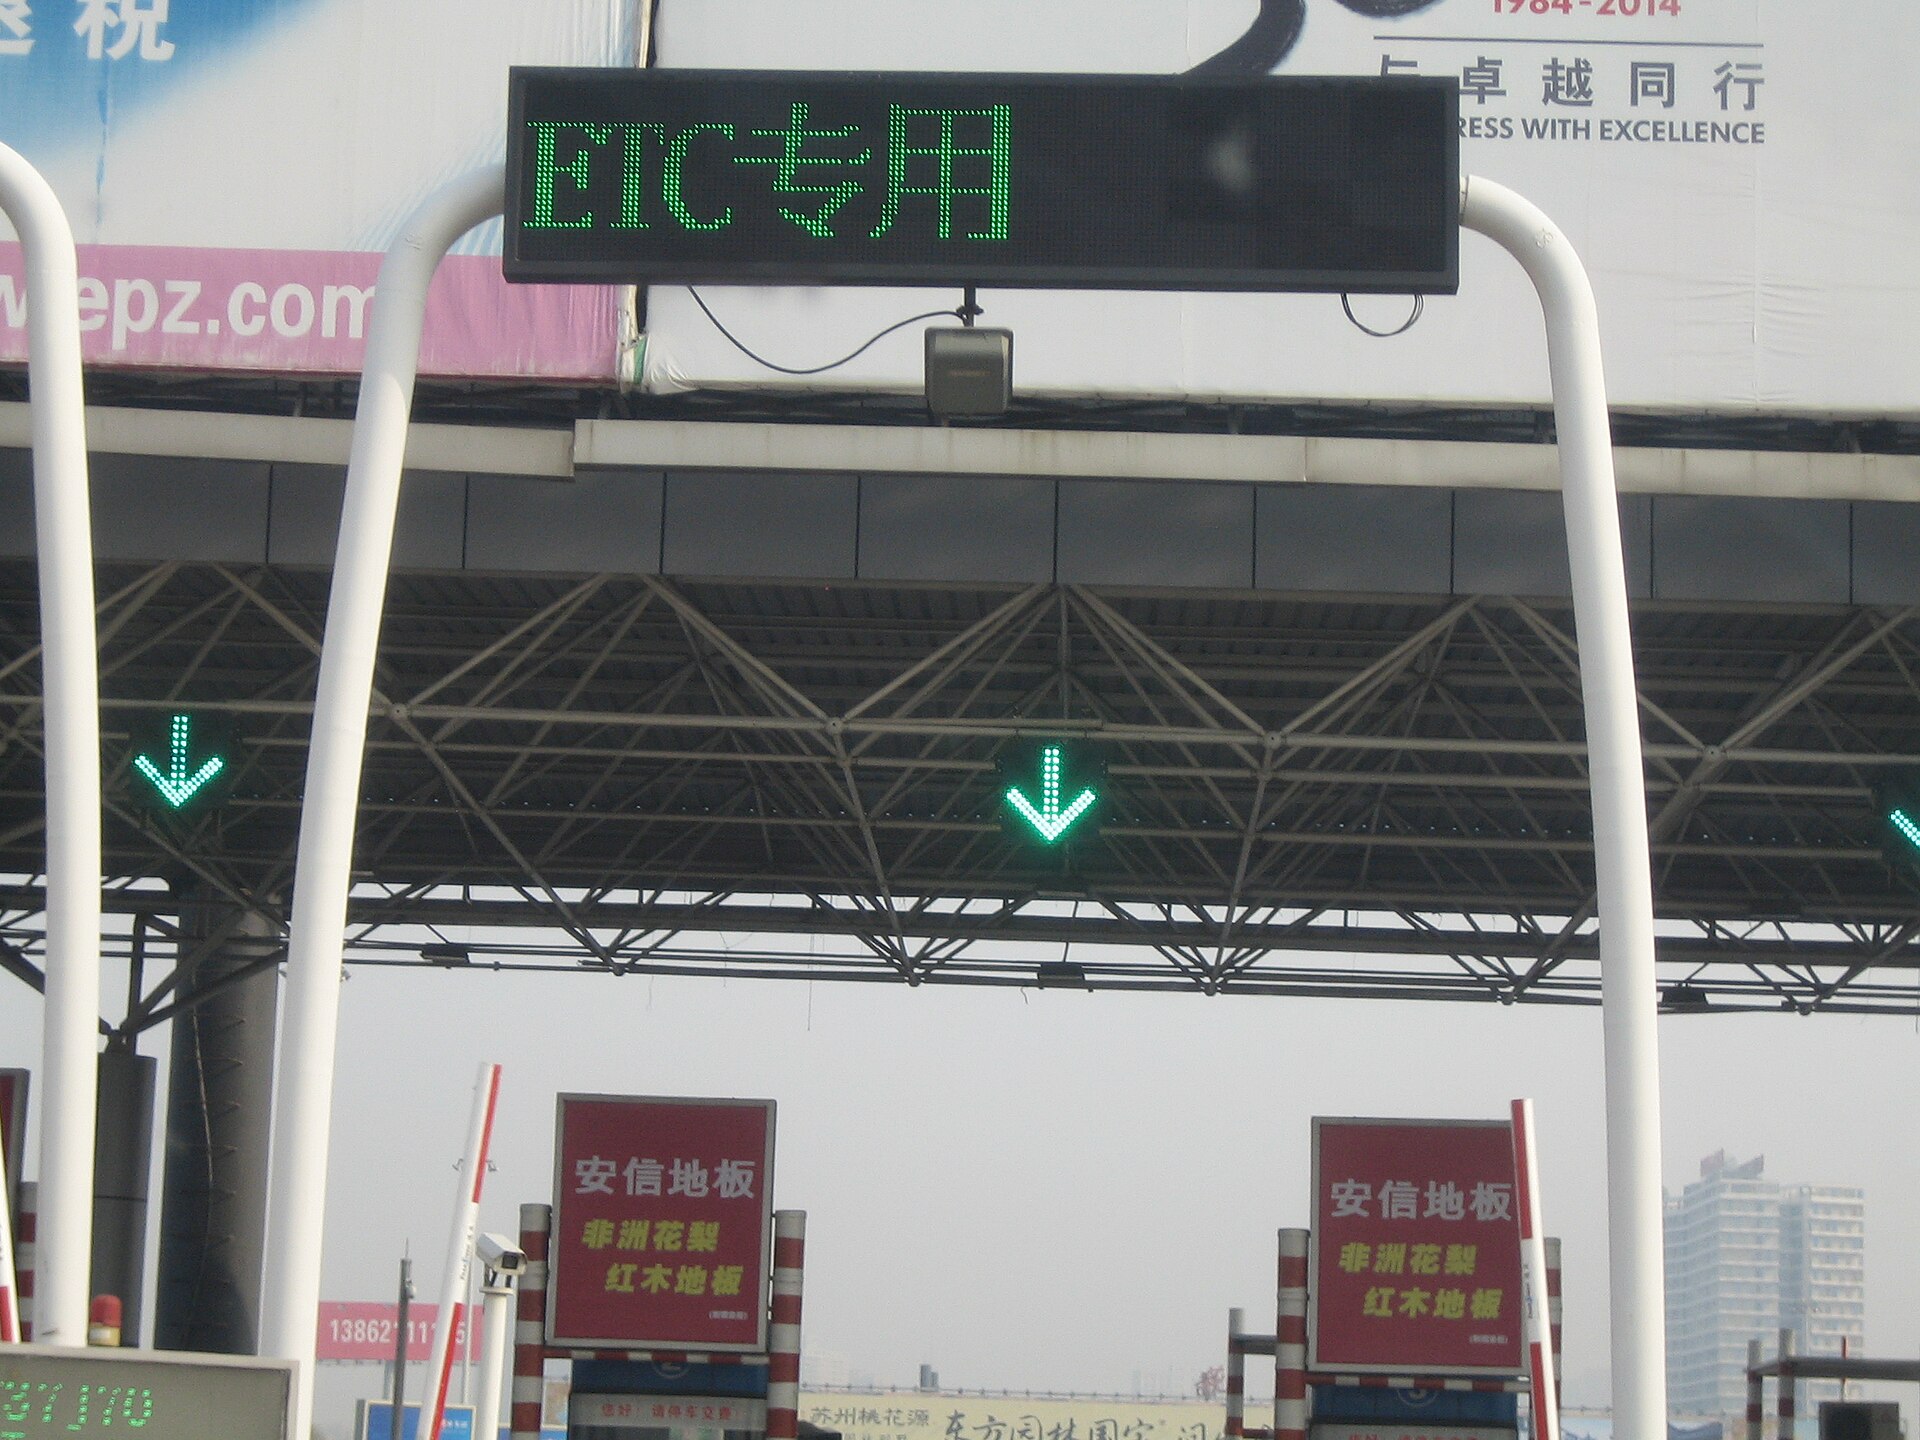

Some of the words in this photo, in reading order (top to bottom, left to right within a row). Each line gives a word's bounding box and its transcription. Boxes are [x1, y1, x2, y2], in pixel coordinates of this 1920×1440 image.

[1521, 118, 1591, 141] WITH
[1600, 119, 1765, 144] EXCELLENCE
[574, 1155, 756, 1199] 安信地板
[1330, 1178, 1512, 1221] 安信地板
[581, 1218, 720, 1252] 非洲花梨
[1338, 1242, 1477, 1276] 非洲花梨
[604, 1263, 744, 1297] 红木地板
[1362, 1286, 1503, 1319] 红木地板
